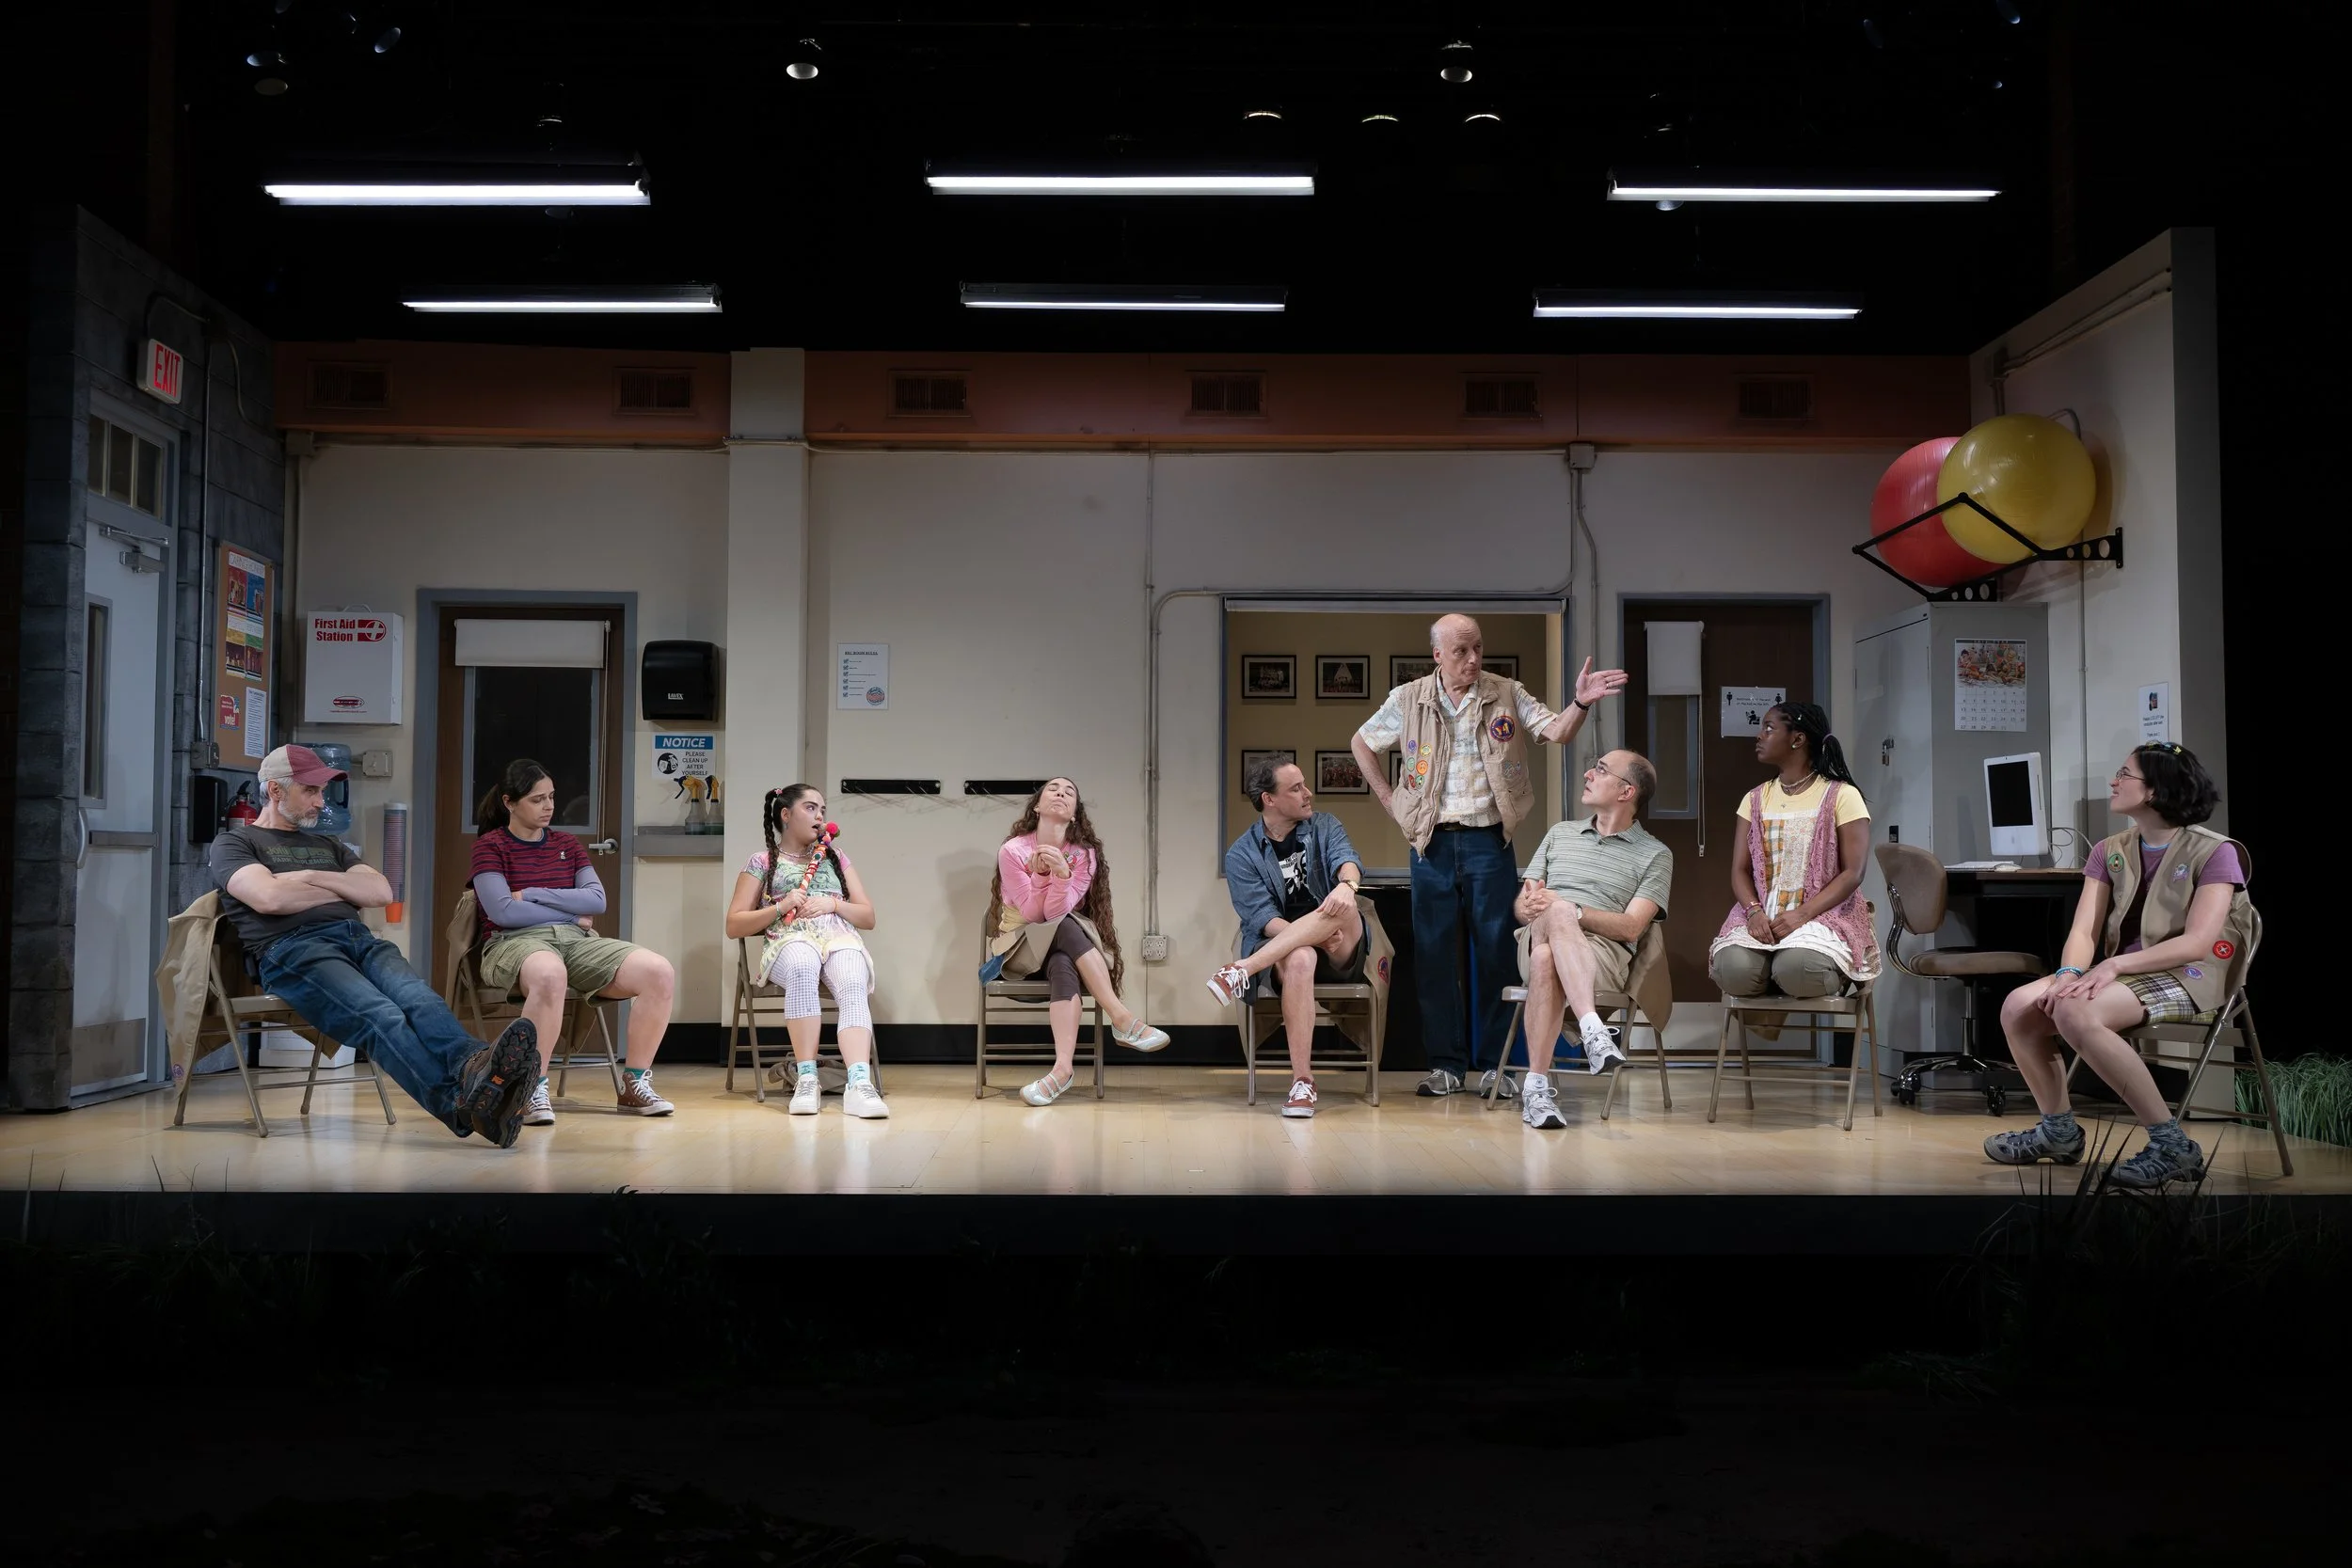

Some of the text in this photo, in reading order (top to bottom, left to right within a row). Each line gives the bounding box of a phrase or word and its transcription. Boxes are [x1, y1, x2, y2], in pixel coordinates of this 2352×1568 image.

[154, 343, 181, 398] EXIT
[314, 618, 356, 629] First Aid
[316, 631, 353, 641] Station
[662, 737, 706, 748] NOTICE
